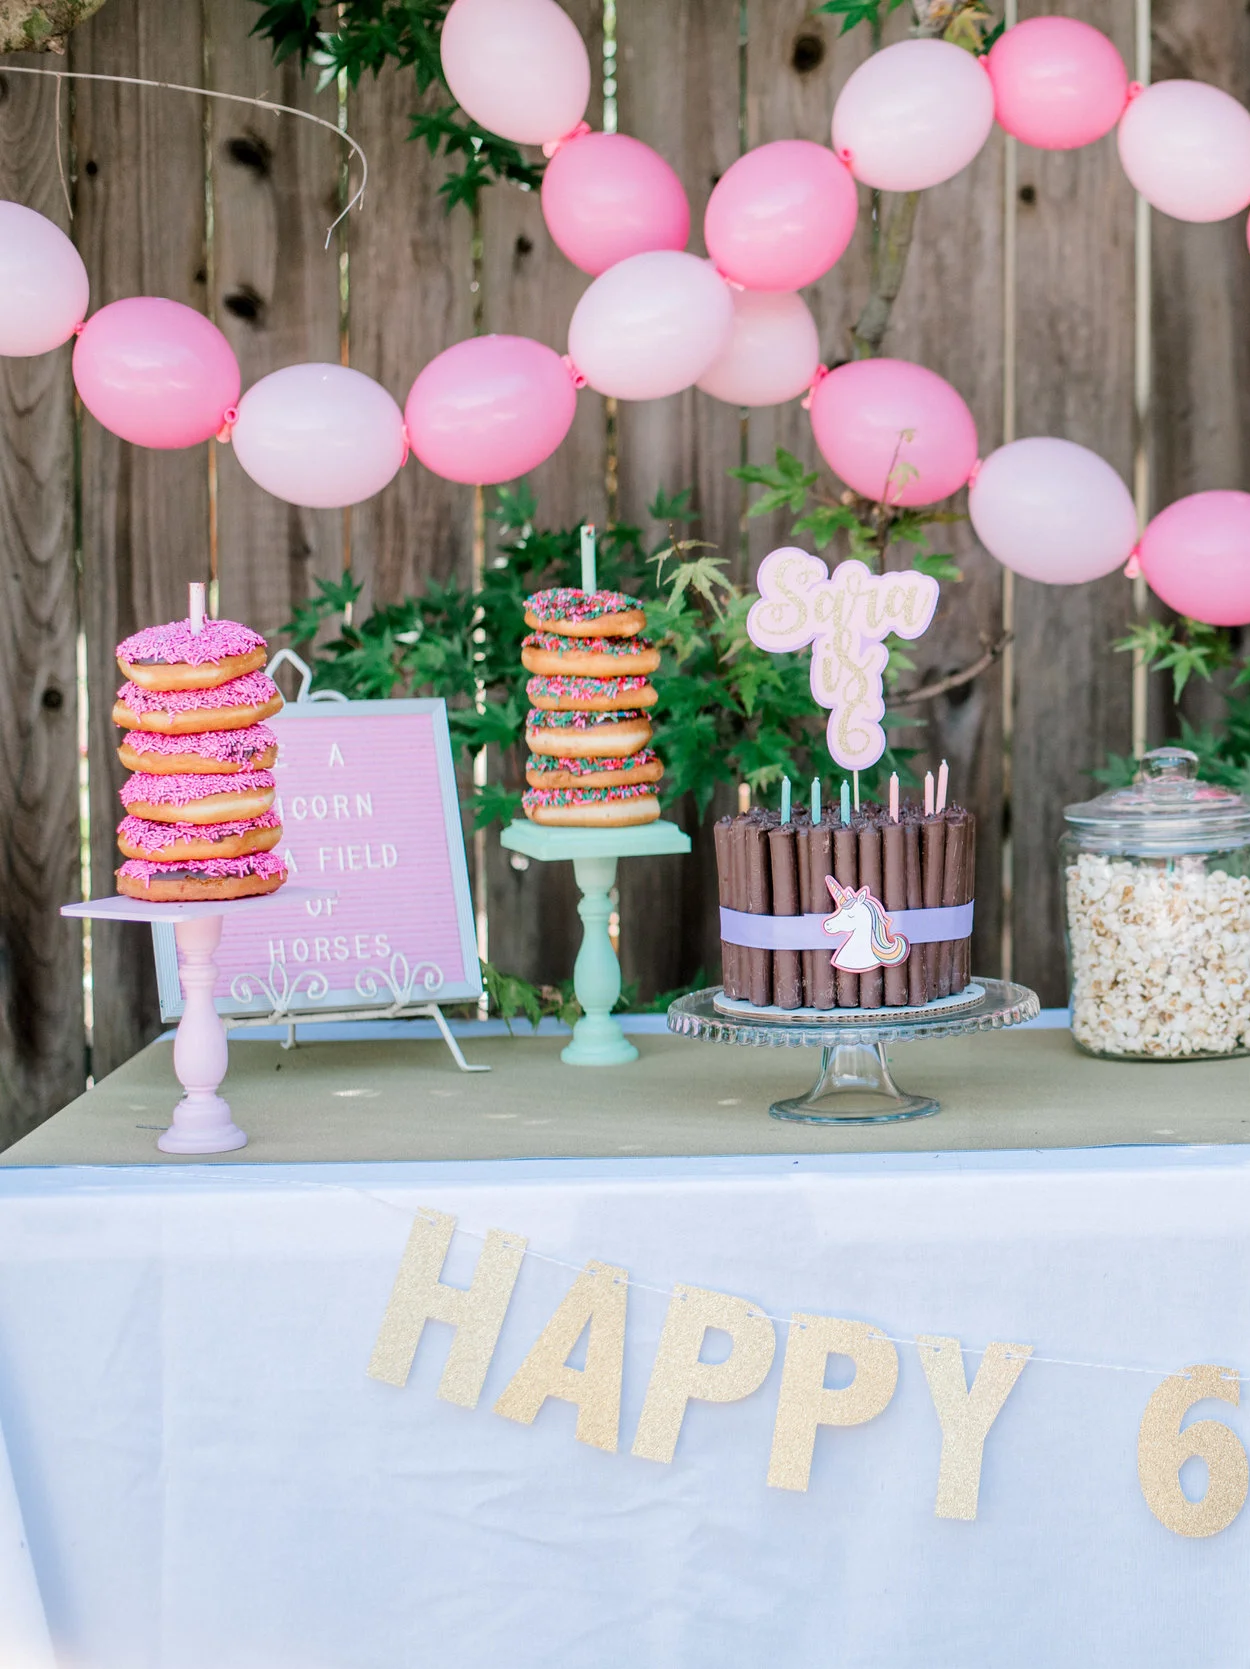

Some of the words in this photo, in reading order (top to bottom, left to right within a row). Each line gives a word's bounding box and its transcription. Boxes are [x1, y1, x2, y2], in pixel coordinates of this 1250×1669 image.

[837, 699, 871, 756] 6
[329, 743, 345, 767] A
[277, 792, 373, 820] ICORN
[283, 848, 298, 873] A
[319, 843, 398, 872] FIELD
[268, 934, 391, 964] HORSES
[365, 1206, 1034, 1521] HAPPY
[1137, 1364, 1249, 1538] 6
